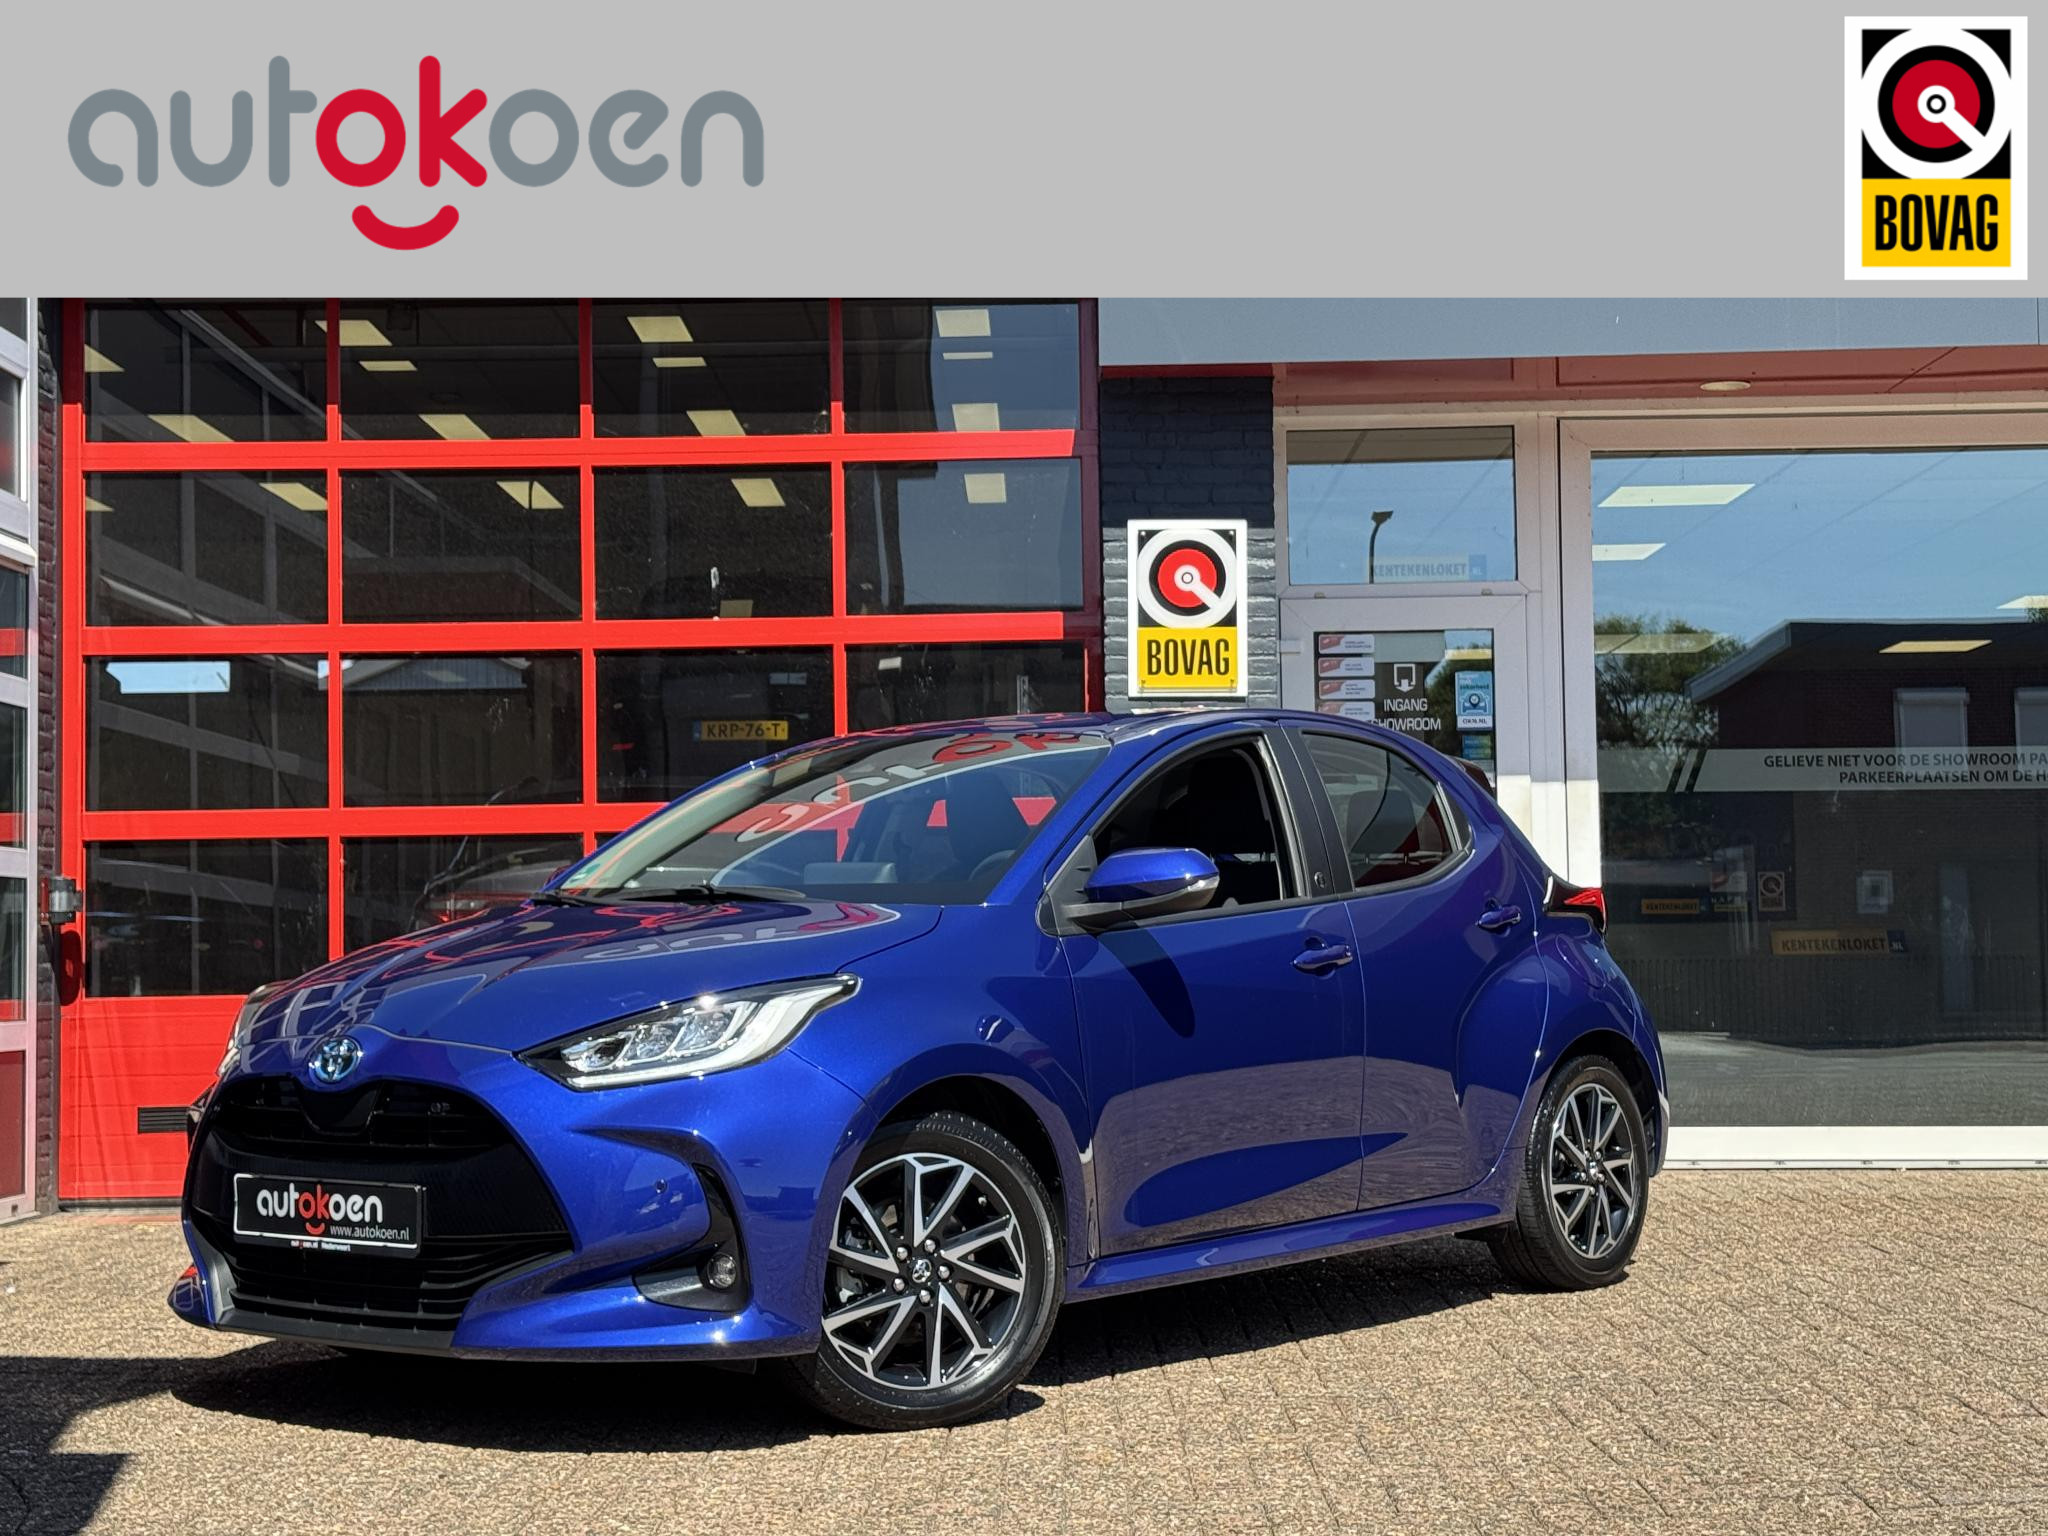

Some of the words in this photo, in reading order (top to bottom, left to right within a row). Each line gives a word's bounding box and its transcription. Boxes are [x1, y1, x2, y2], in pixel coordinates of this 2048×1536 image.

[1147, 638, 1230, 676] BOVAG
[1383, 698, 1428, 712] INGANG
[706, 722, 781, 738] KRP-76-T
[1764, 755, 1825, 768] GELIEVE
[1827, 754, 1861, 768] NIET
[1863, 754, 1906, 767] VOOR
[1910, 754, 1930, 767] DE
[1933, 753, 2026, 767] SHOWROOM
[1839, 770, 1980, 784] PARKEERPLAATSEN
[1983, 769, 2009, 783] OM
[2012, 769, 2033, 782] DE
[2036, 769, 2048, 782] H
[1782, 937, 1886, 952] KENTEKENLOKET
[256, 1182, 384, 1223] autokoen
[329, 1224, 410, 1241] www.autokoen.nl
